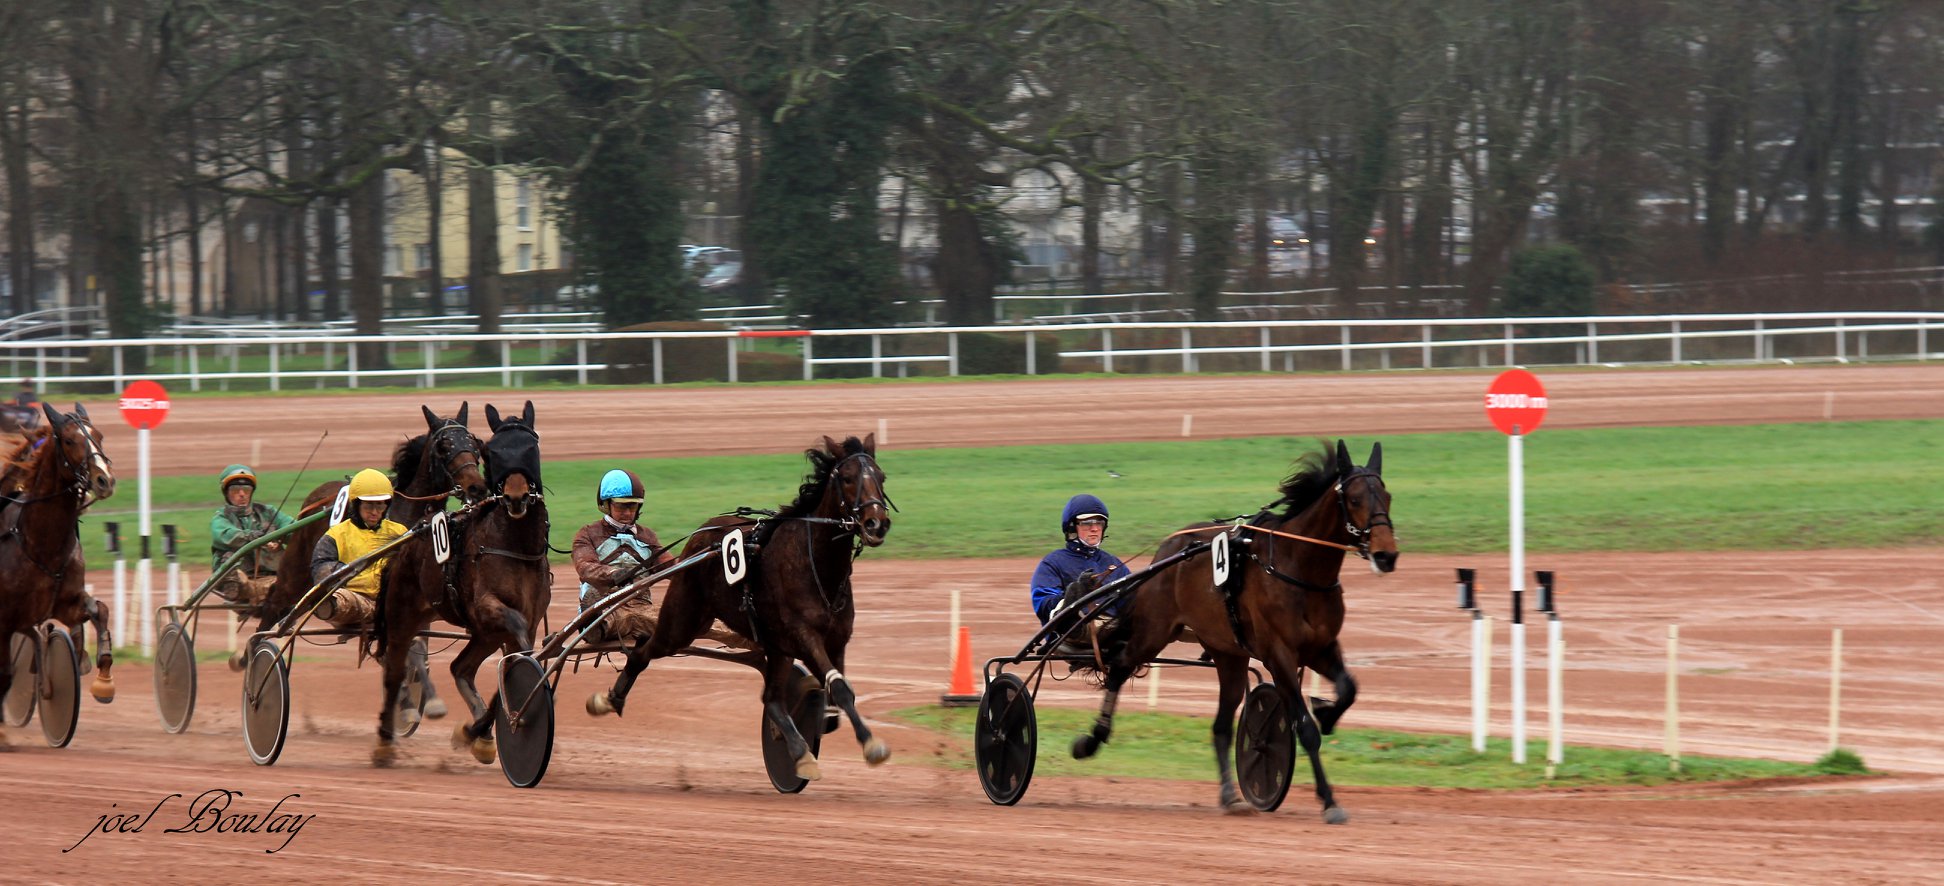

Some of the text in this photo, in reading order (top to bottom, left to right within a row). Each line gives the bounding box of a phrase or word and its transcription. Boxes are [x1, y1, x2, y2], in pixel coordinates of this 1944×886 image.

[155, 401, 170, 409] m
[1485, 394, 1548, 408] 3000 m
[334, 490, 347, 520] 3
[433, 518, 449, 556] 10
[727, 537, 740, 575] 6
[1216, 538, 1226, 573] 4
